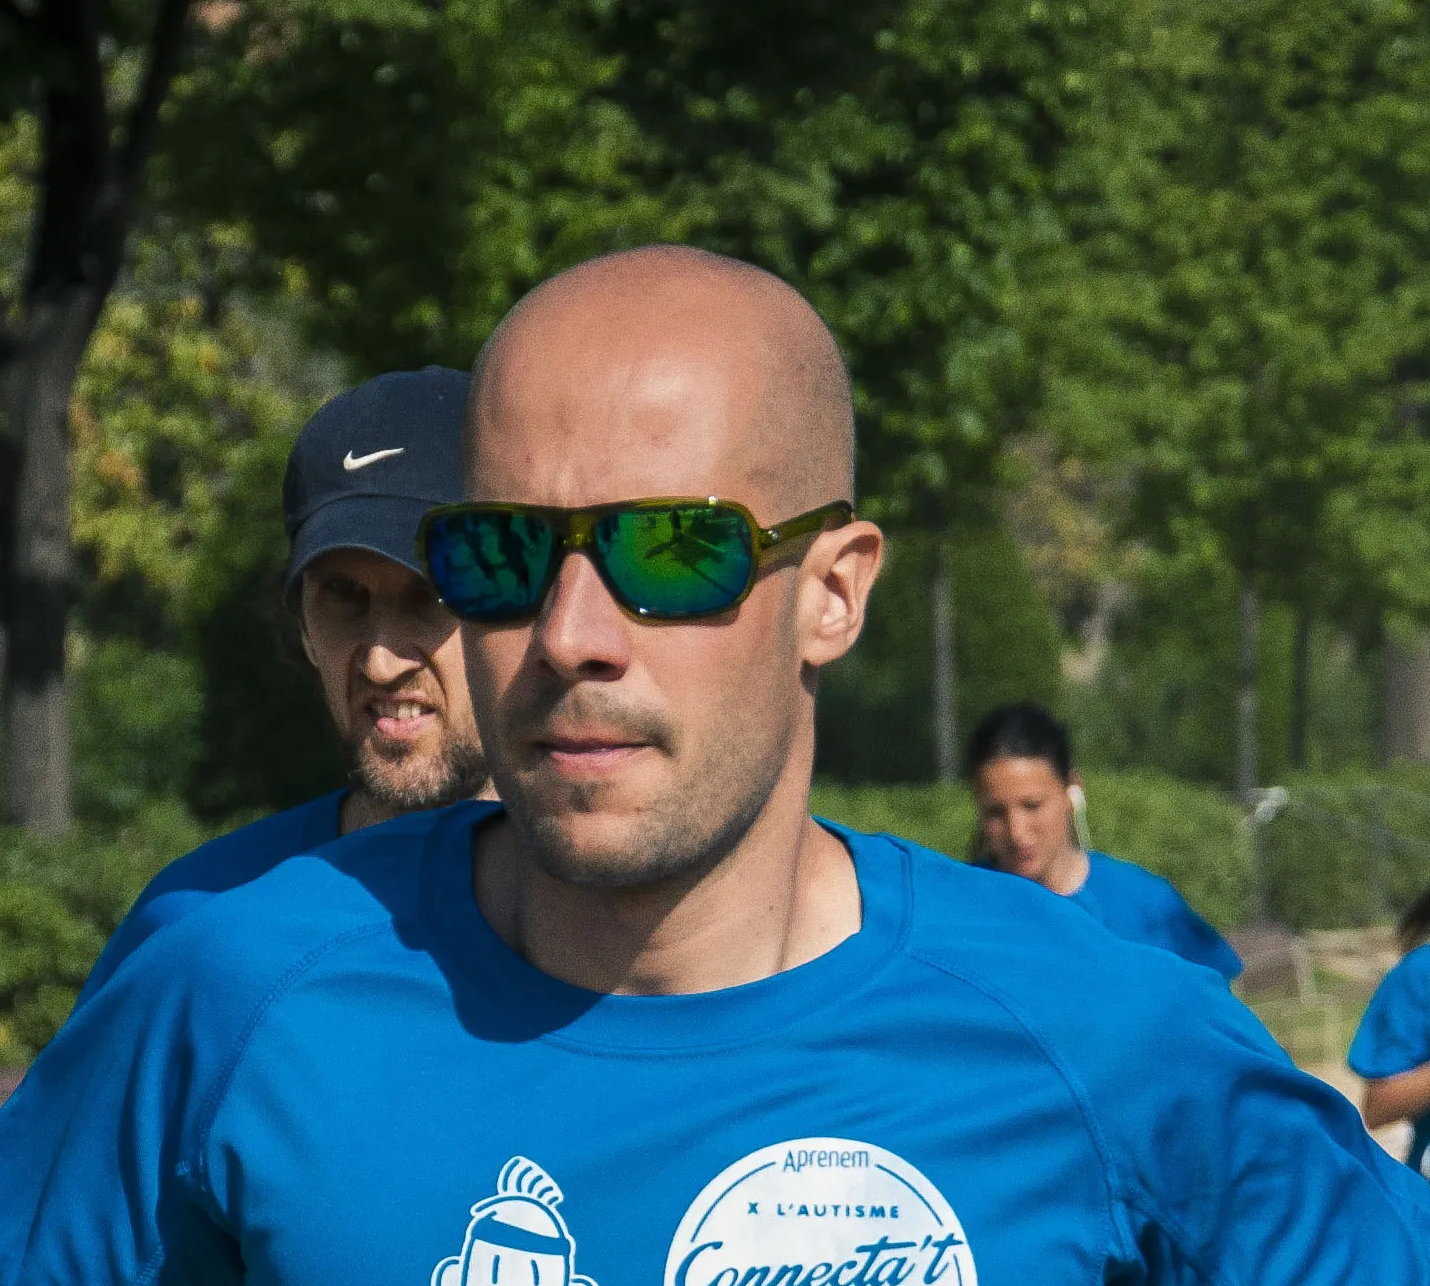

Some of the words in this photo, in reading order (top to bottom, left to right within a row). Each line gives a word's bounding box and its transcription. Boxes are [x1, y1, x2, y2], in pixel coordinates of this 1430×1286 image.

[782, 1149, 871, 1174] Aprenem
[746, 1201, 760, 1216] X
[776, 1203, 901, 1220] L'AUTISME
